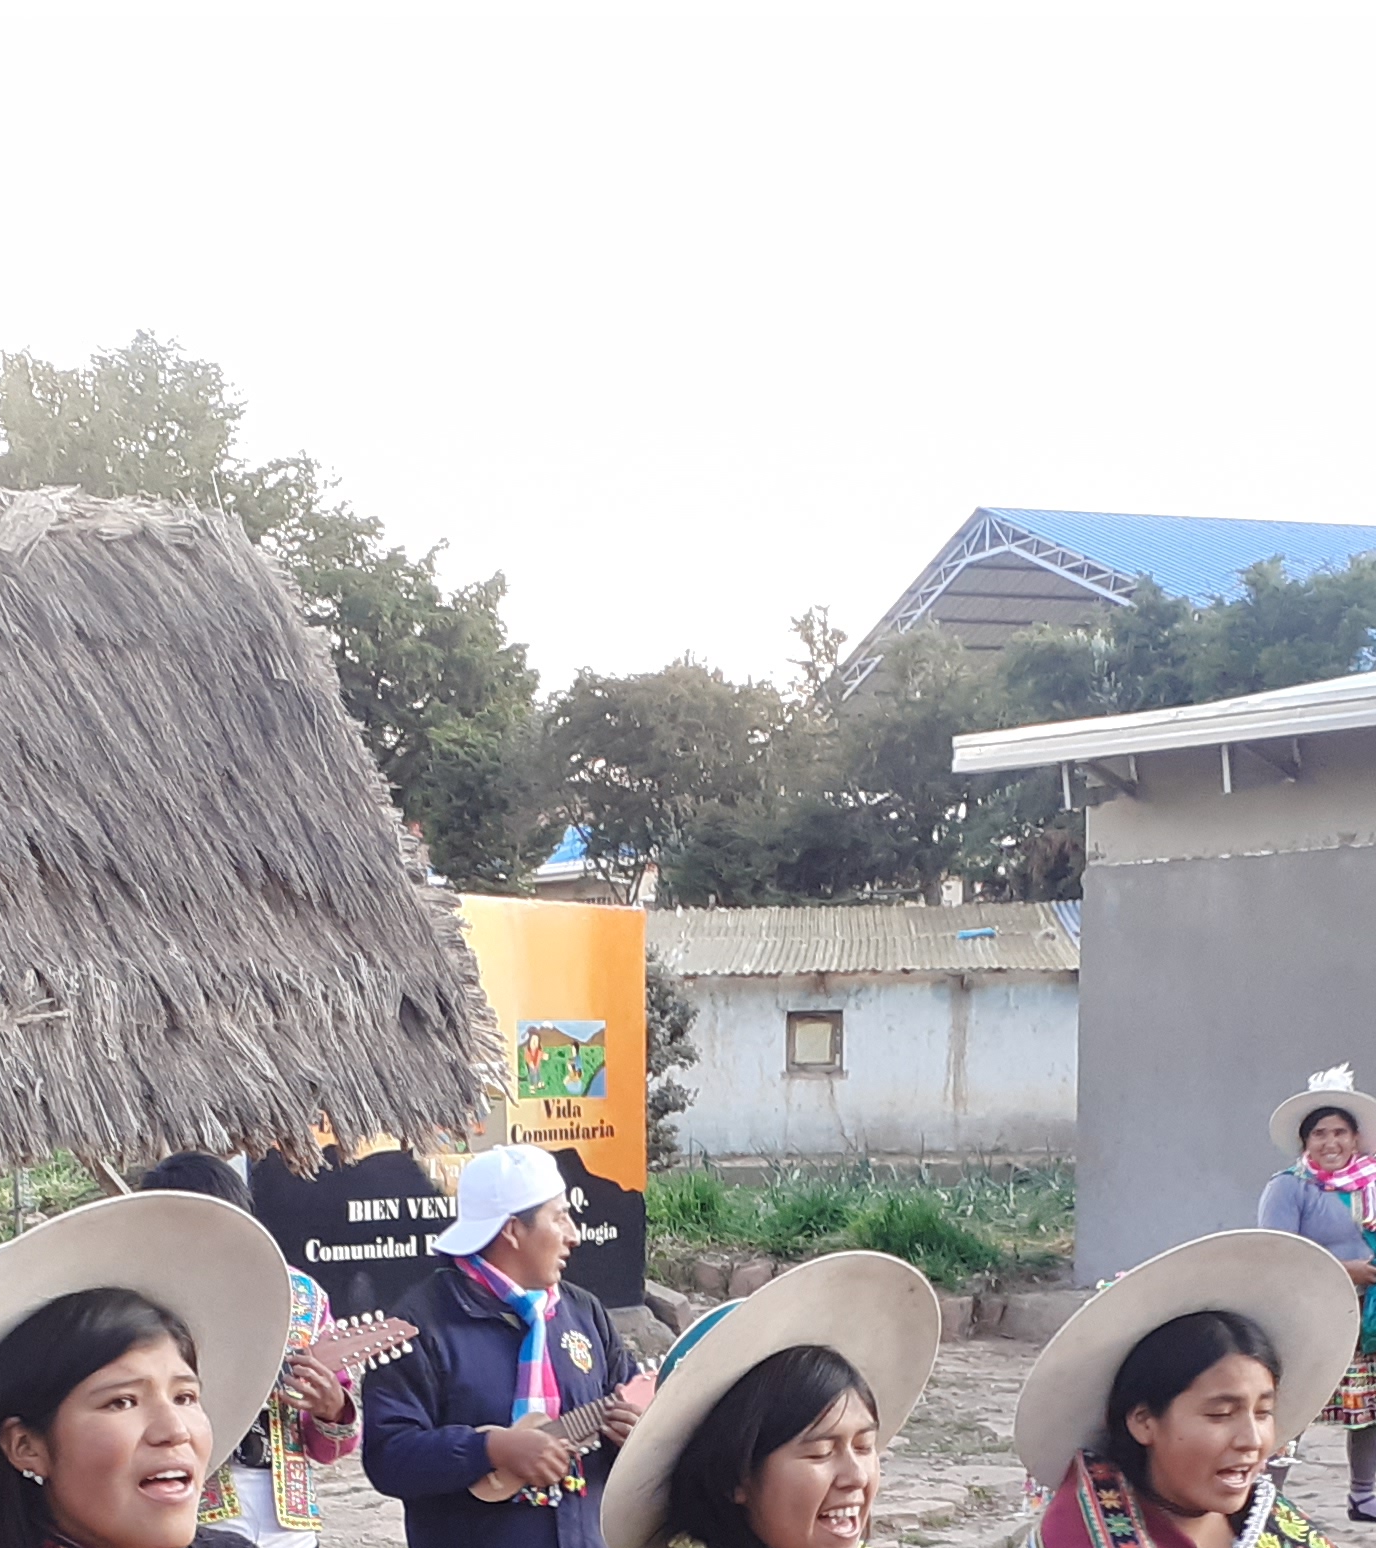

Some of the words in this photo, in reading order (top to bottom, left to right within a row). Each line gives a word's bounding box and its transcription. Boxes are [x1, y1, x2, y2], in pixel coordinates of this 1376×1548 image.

[543, 1099, 582, 1119] Vida
[511, 1119, 615, 1143] Comunitaria
[347, 1199, 401, 1222] BIEN
[406, 1196, 457, 1220] VENI
[305, 1235, 418, 1263] Comunidad
